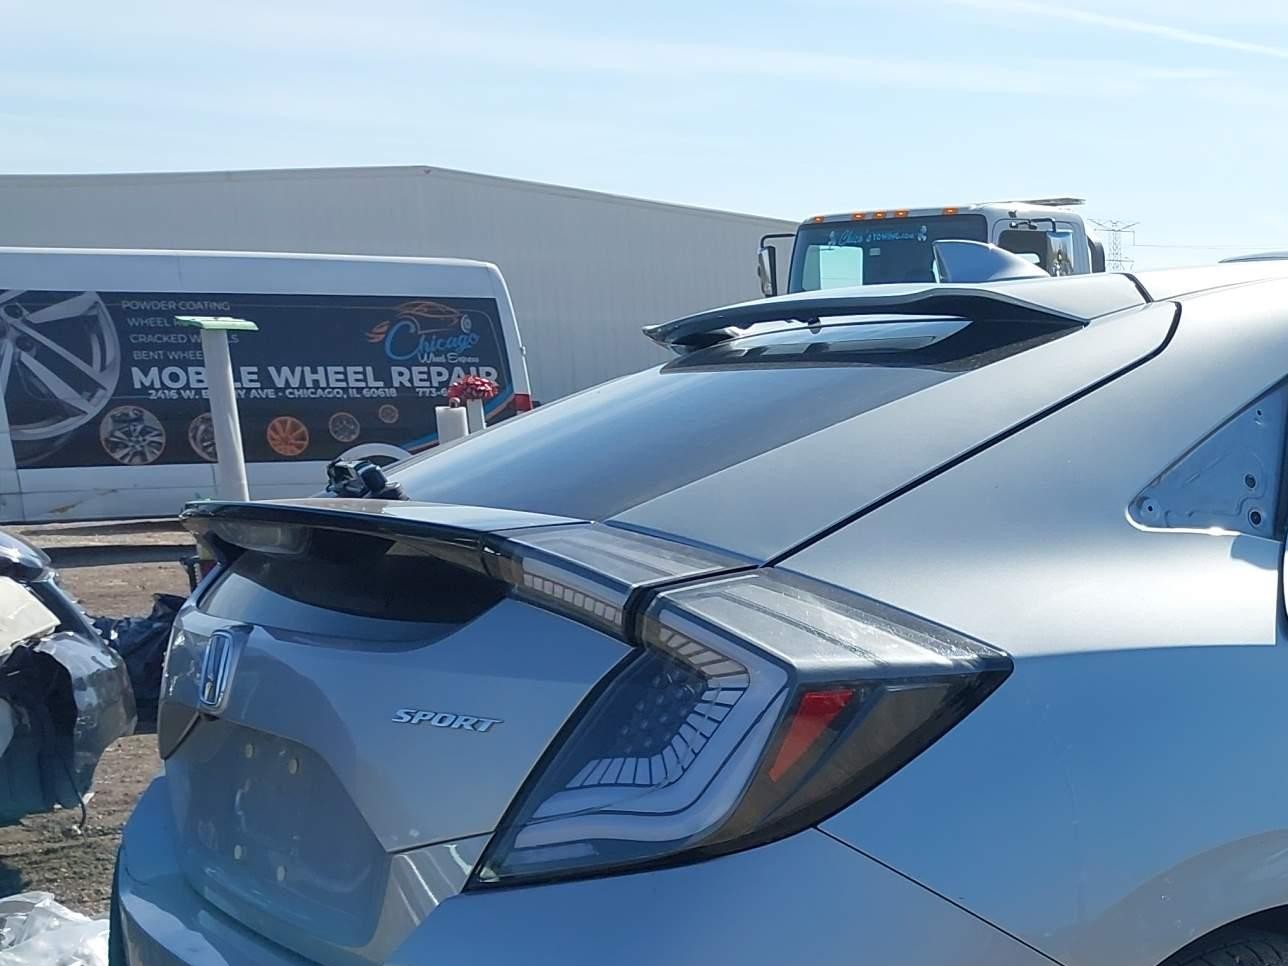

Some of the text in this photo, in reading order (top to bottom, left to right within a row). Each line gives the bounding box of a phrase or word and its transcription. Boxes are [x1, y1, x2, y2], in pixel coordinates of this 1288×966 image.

[121, 300, 231, 311] POWDER COATING
[127, 317, 171, 327] WHEEL
[130, 334, 188, 343] CRACKED
[385, 320, 480, 360] Chicago
[133, 351, 164, 360] BENT
[267, 366, 384, 388] WHEEL
[250, 388, 276, 398] AVE
[285, 388, 347, 398] CHICAGO,
[349, 388, 360, 398] IL
[392, 709, 504, 732] SPORT
